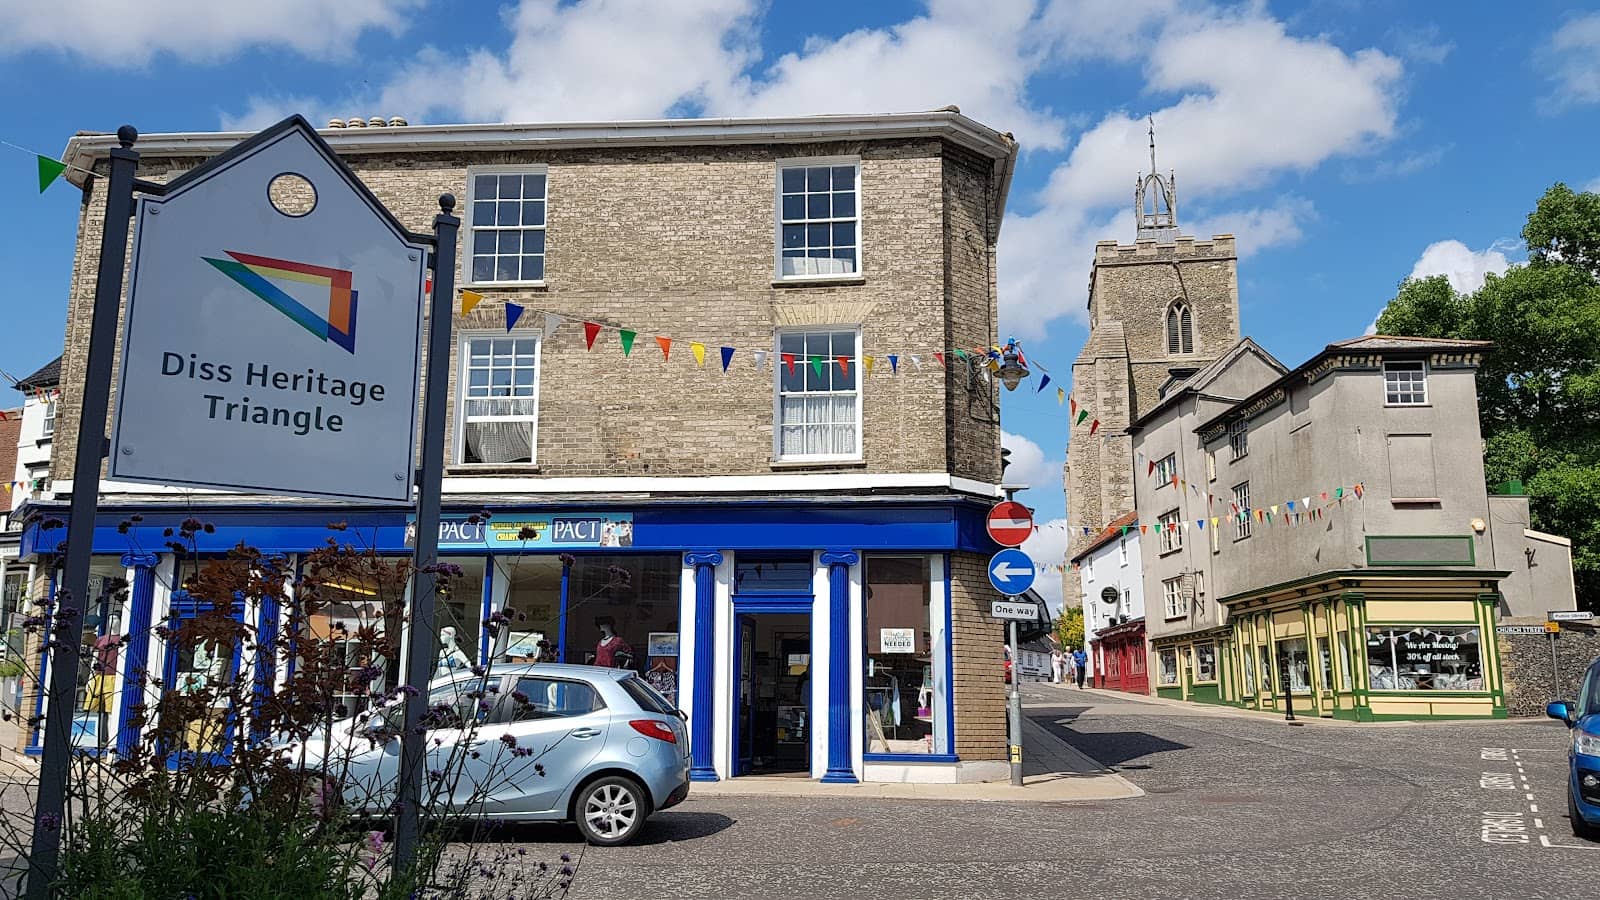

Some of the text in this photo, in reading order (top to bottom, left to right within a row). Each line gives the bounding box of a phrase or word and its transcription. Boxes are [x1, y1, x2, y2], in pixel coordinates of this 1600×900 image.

[161, 351, 385, 406] Diss Heritage
[203, 394, 344, 436] Triangle
[438, 521, 484, 540] PACT
[554, 520, 599, 539] PACT
[995, 605, 1034, 616] One way
[1405, 641, 1459, 650] We Are Moving!
[1406, 652, 1421, 661] 30%
[1423, 652, 1432, 662] off
